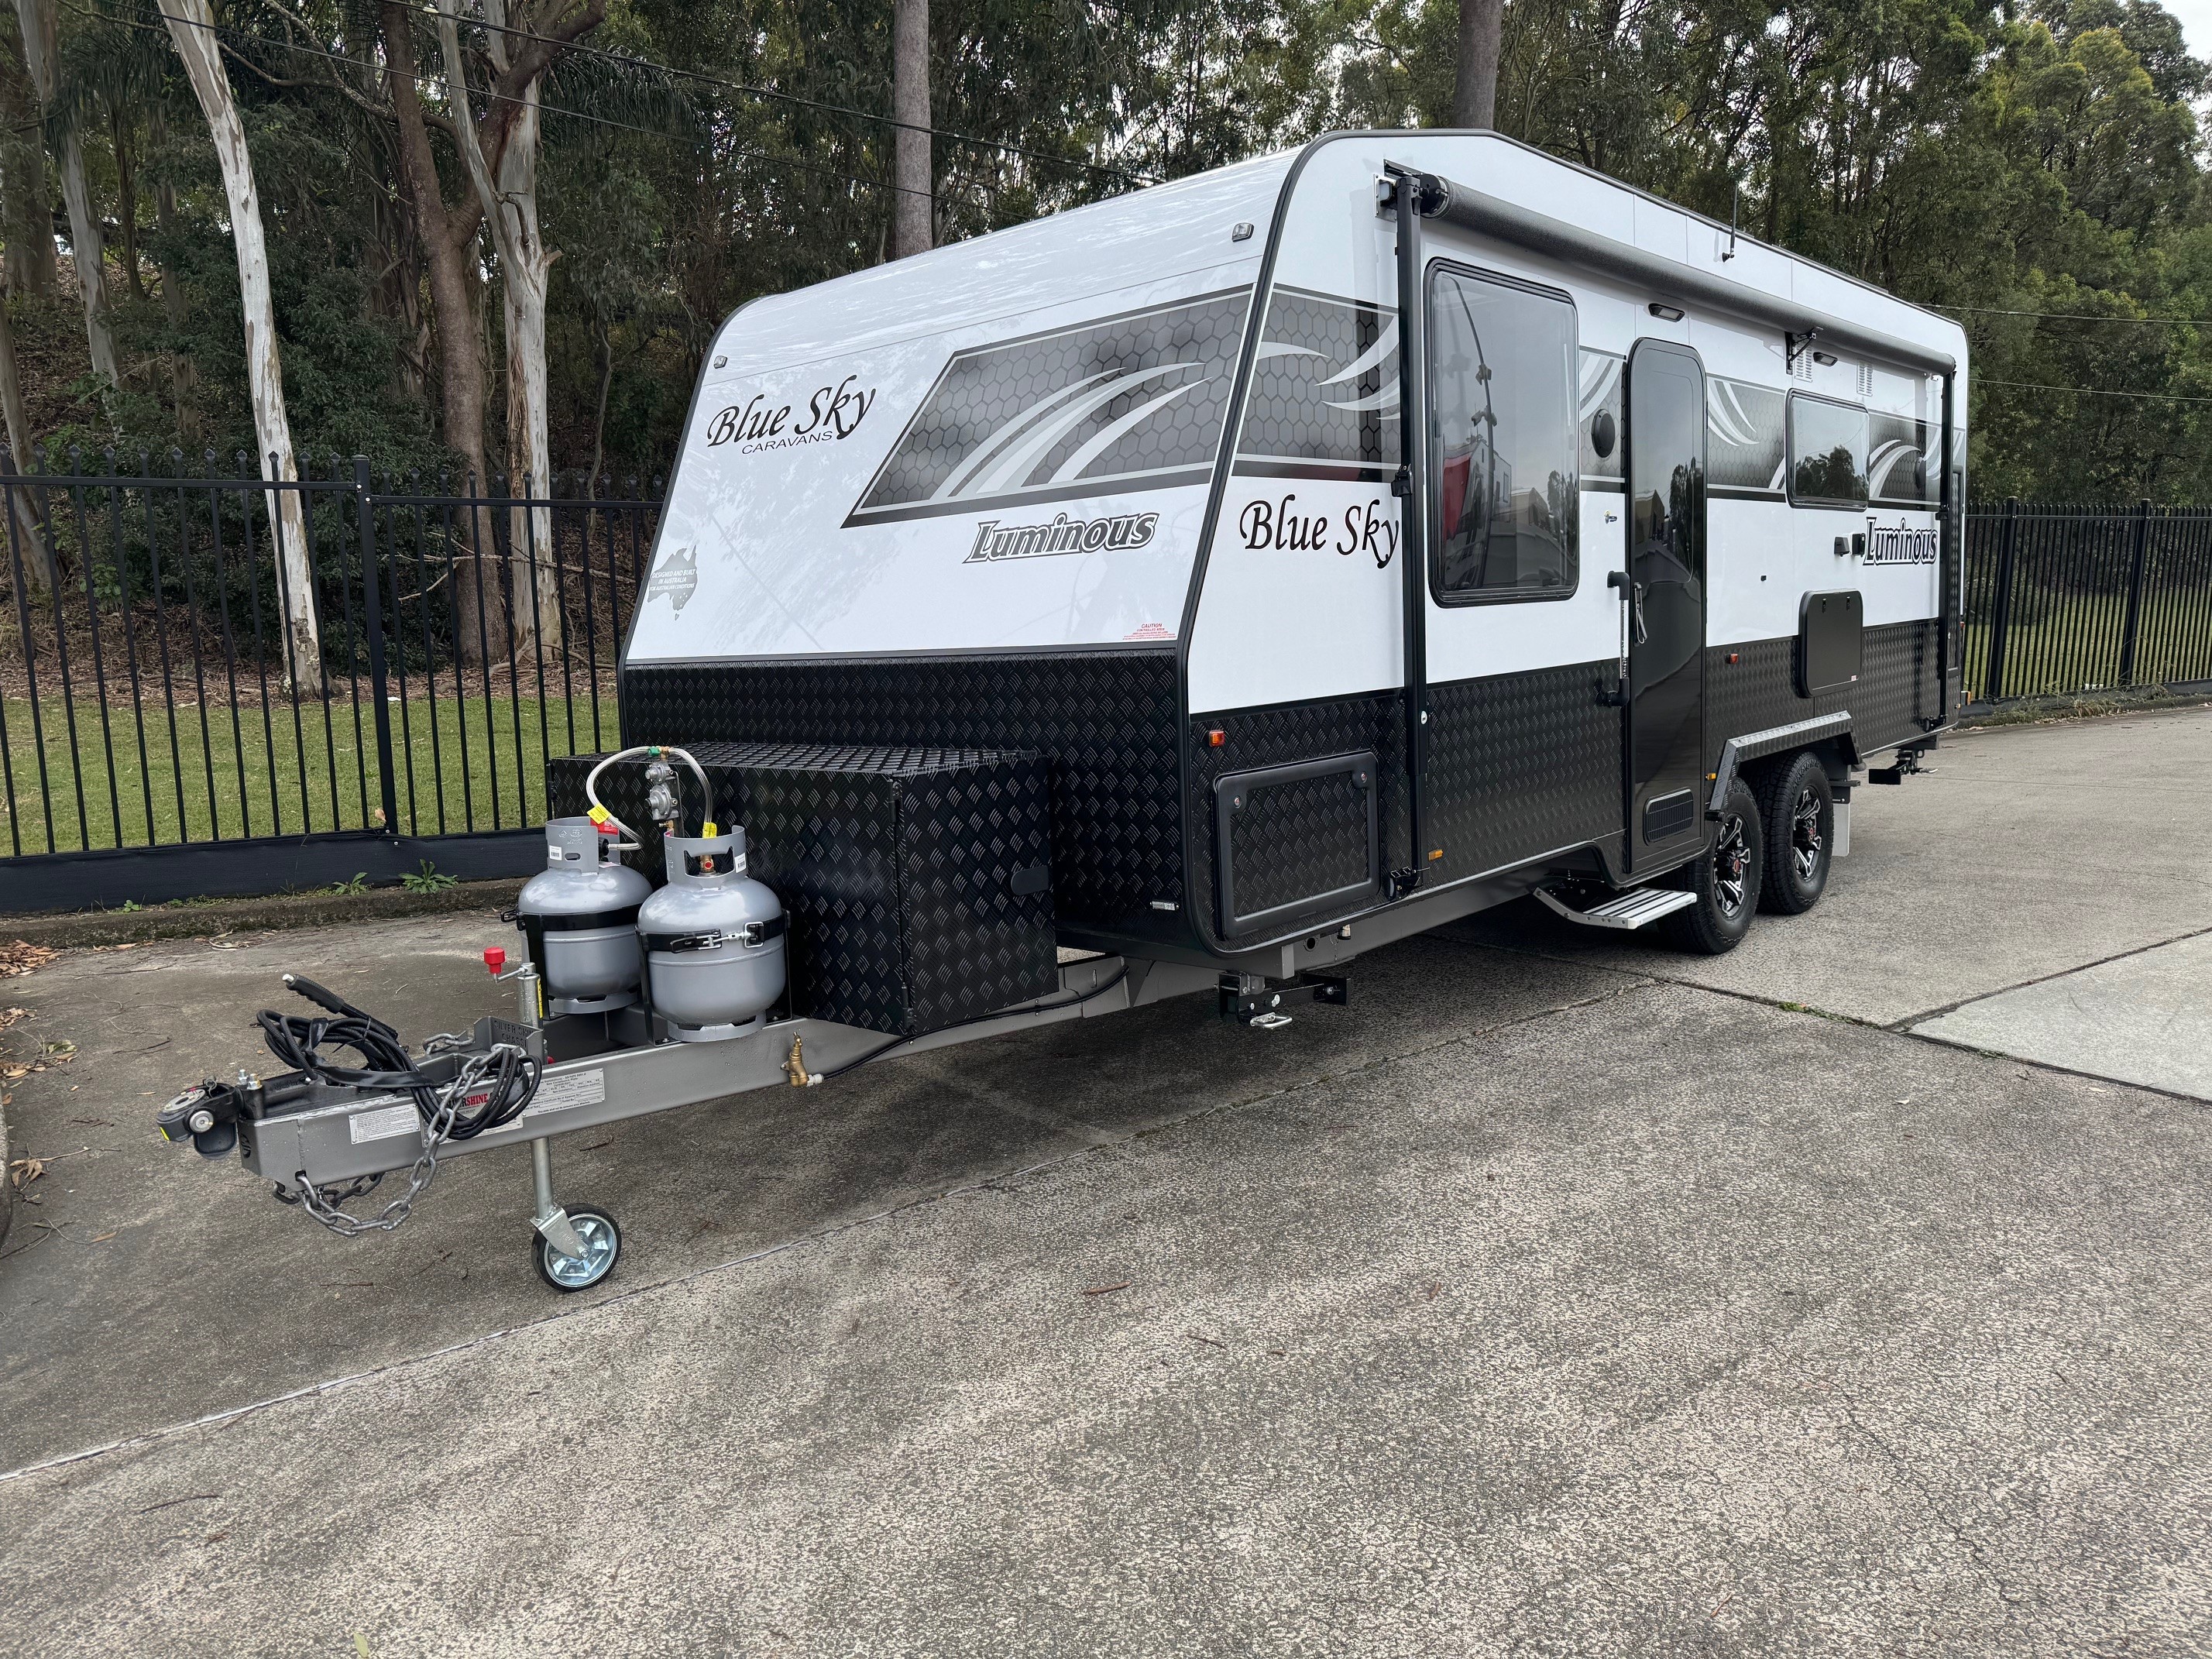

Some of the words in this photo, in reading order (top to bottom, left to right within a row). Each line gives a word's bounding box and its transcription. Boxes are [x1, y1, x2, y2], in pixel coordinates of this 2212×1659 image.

[707, 393, 791, 447] Blue
[794, 374, 877, 440] Sky
[741, 431, 833, 455] CARAVANS
[962, 512, 1160, 564] Luminous
[1239, 494, 1328, 551] Blue
[1336, 499, 1400, 569] Sky
[1863, 516, 1938, 565] Luminous
[494, 1020, 515, 1033] SILVER
[502, 1033, 527, 1048] CHASSI
